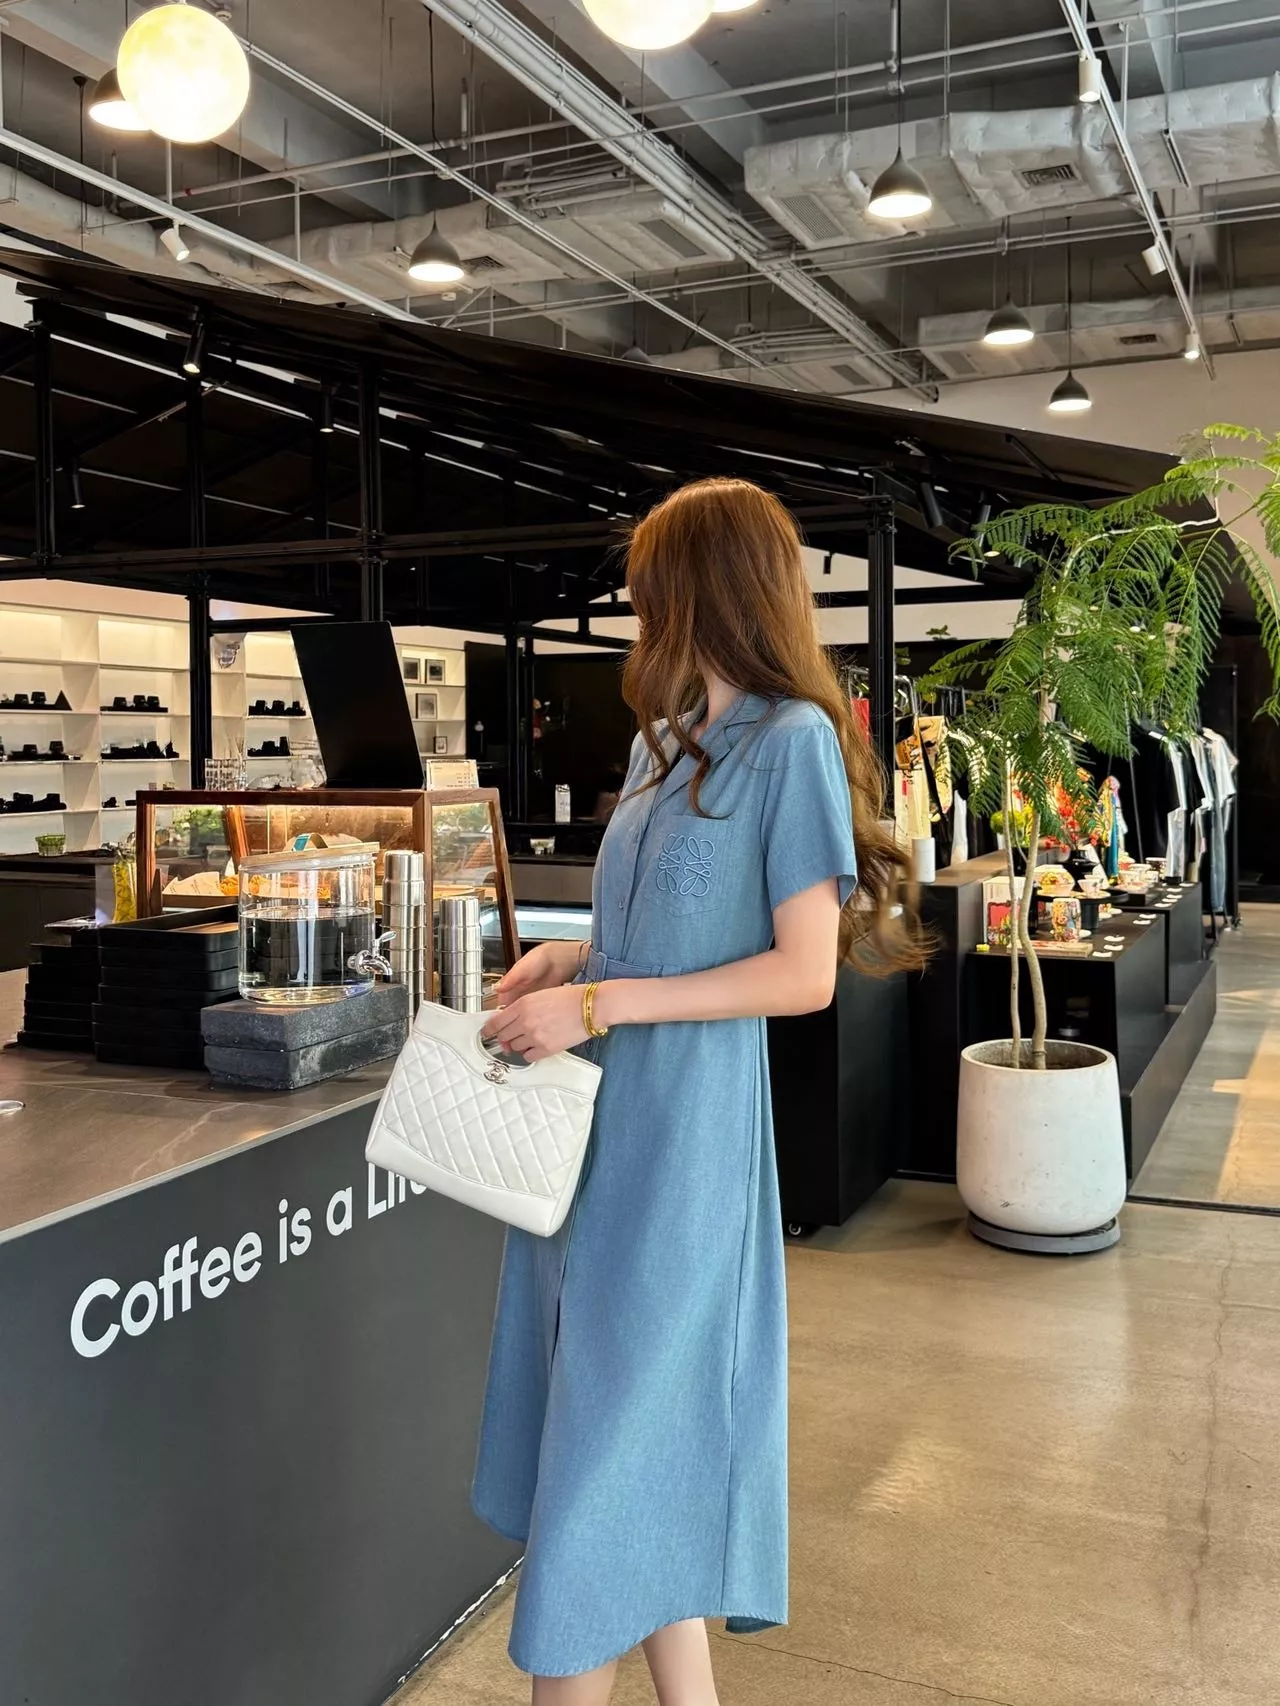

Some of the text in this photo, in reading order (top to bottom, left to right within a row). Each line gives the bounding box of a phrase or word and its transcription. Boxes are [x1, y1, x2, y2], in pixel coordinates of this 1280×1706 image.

[70, 1231, 263, 1358] Coffee
[278, 1198, 312, 1264] is
[326, 1186, 353, 1237] a
